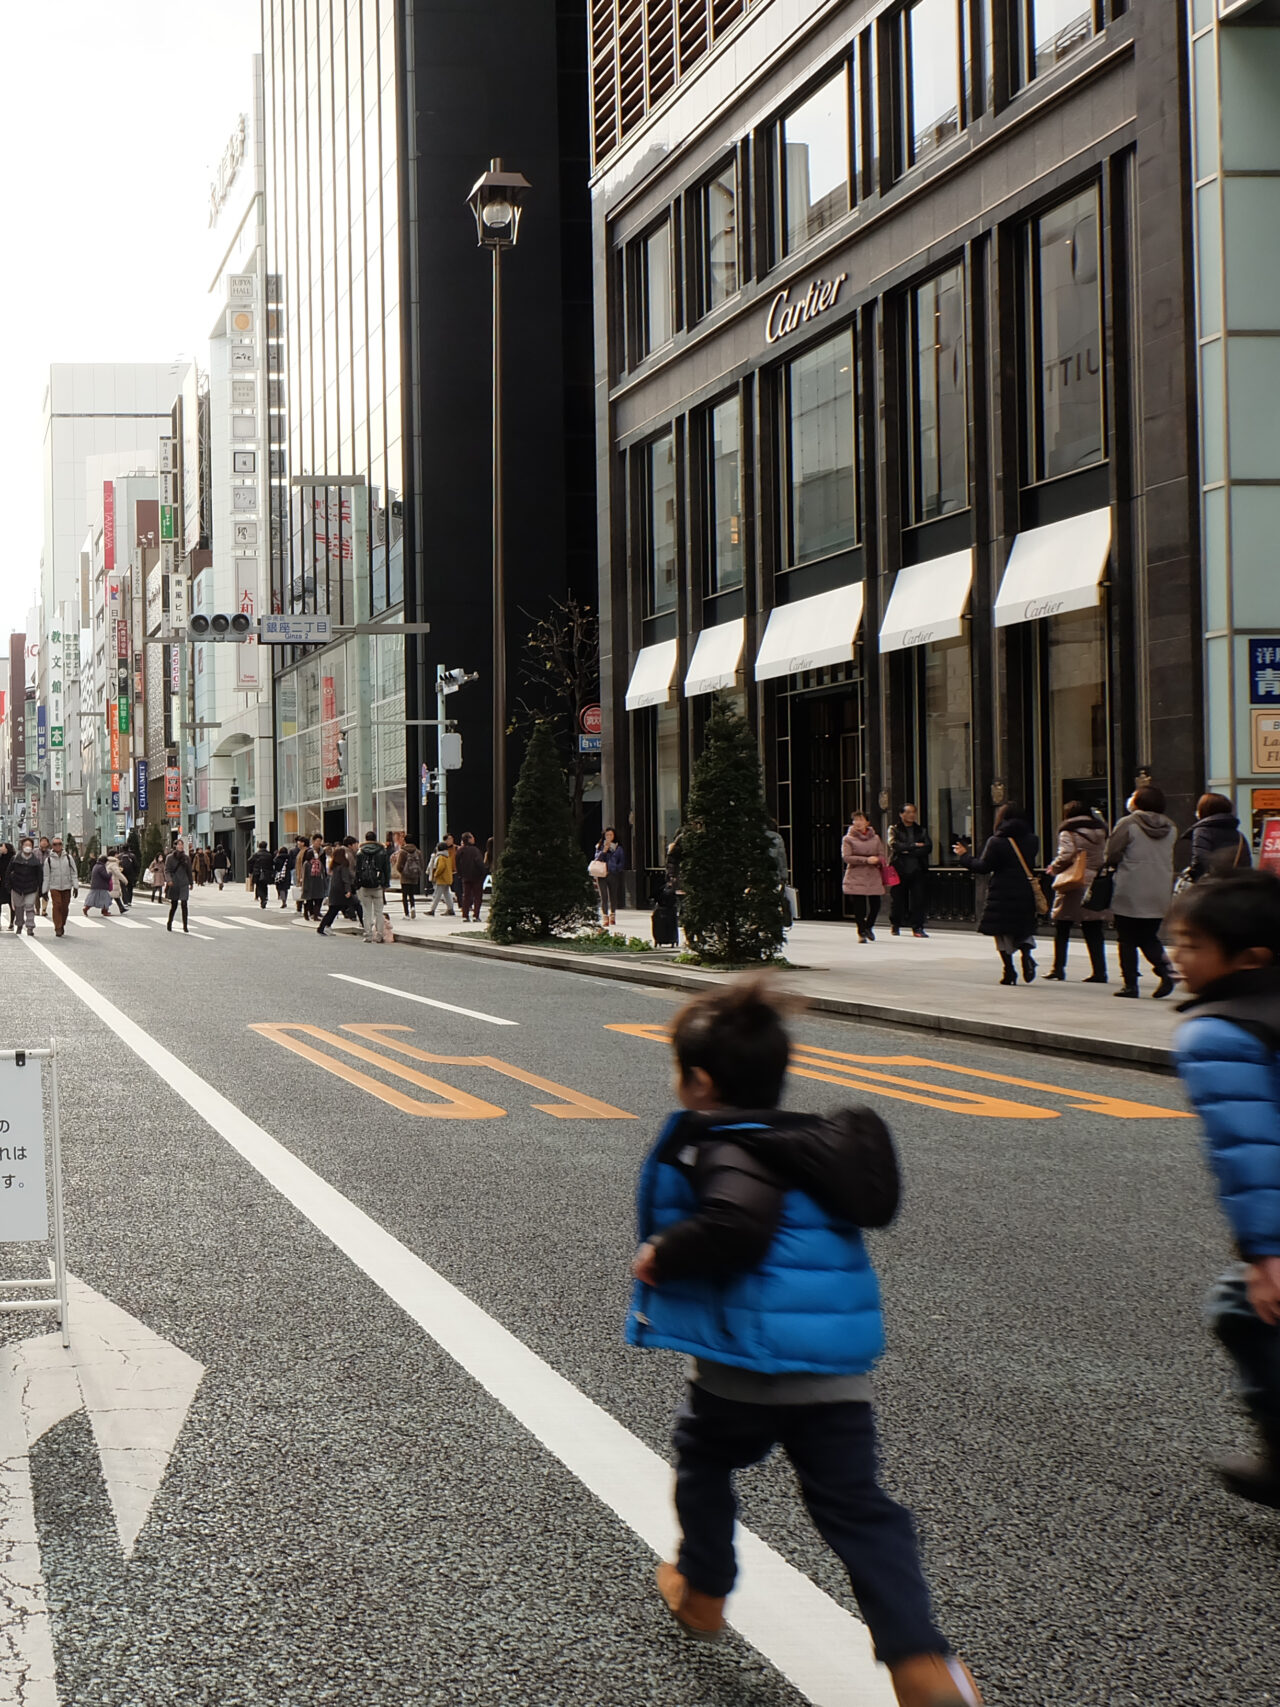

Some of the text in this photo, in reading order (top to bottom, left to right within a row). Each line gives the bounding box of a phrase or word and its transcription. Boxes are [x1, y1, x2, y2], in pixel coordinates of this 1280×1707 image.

[766, 272, 848, 344] Cartier
[104, 511, 113, 549] TAMAYA
[175, 579, 183, 622] 南風ビル
[1024, 600, 1064, 619] Cartier
[266, 622, 327, 633] 銀座二丁目
[901, 629, 934, 646] Cartier
[51, 630, 62, 694] 教文館
[789, 657, 814, 673] Cartier
[52, 729, 62, 744] 本
